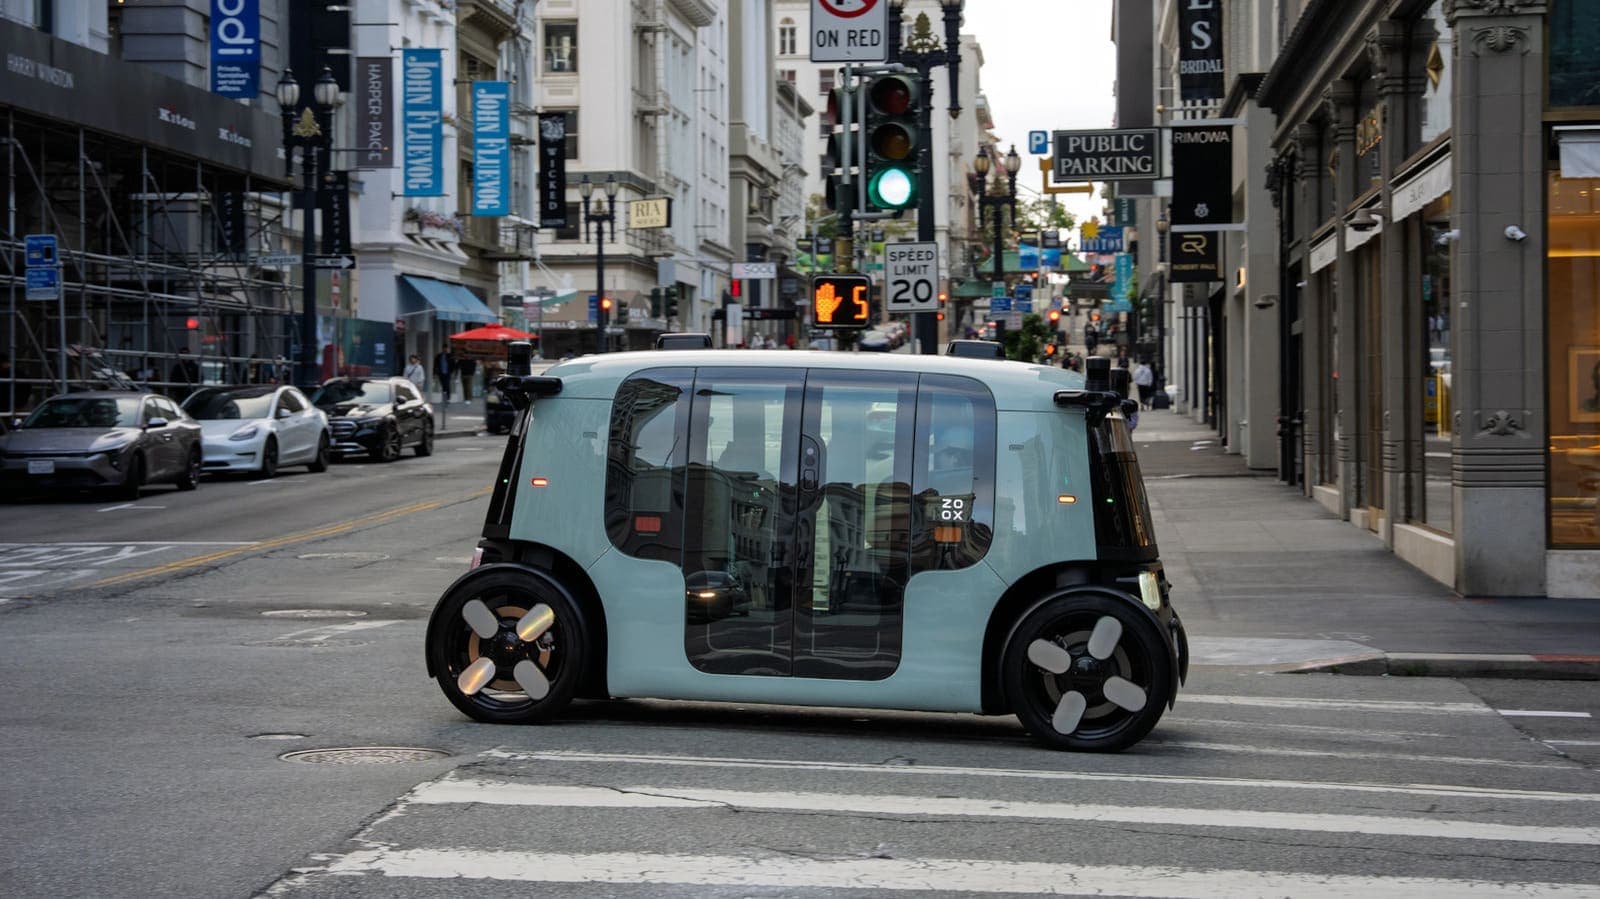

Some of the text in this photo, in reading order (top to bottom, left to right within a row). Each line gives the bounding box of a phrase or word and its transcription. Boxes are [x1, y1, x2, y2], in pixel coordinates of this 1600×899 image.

[816, 28, 881, 48] ON RED
[1180, 59, 1225, 74] BRIDAL
[368, 63, 382, 115] HARPER
[159, 106, 196, 130] Kiton
[406, 56, 441, 190] JOHN FLUEVOG
[1031, 132, 1046, 152] P
[1068, 134, 1145, 153] PUBLIC
[1174, 131, 1230, 144] RIMOWA
[476, 88, 508, 210] JOHN FLUEVOG
[1060, 155, 1153, 175] PARKING
[546, 147, 558, 210] WICKED
[635, 202, 661, 218] RIA
[889, 250, 934, 262] SPEED
[894, 264, 929, 276] LIMIT
[892, 278, 933, 304] 20
[853, 286, 868, 320] 5
